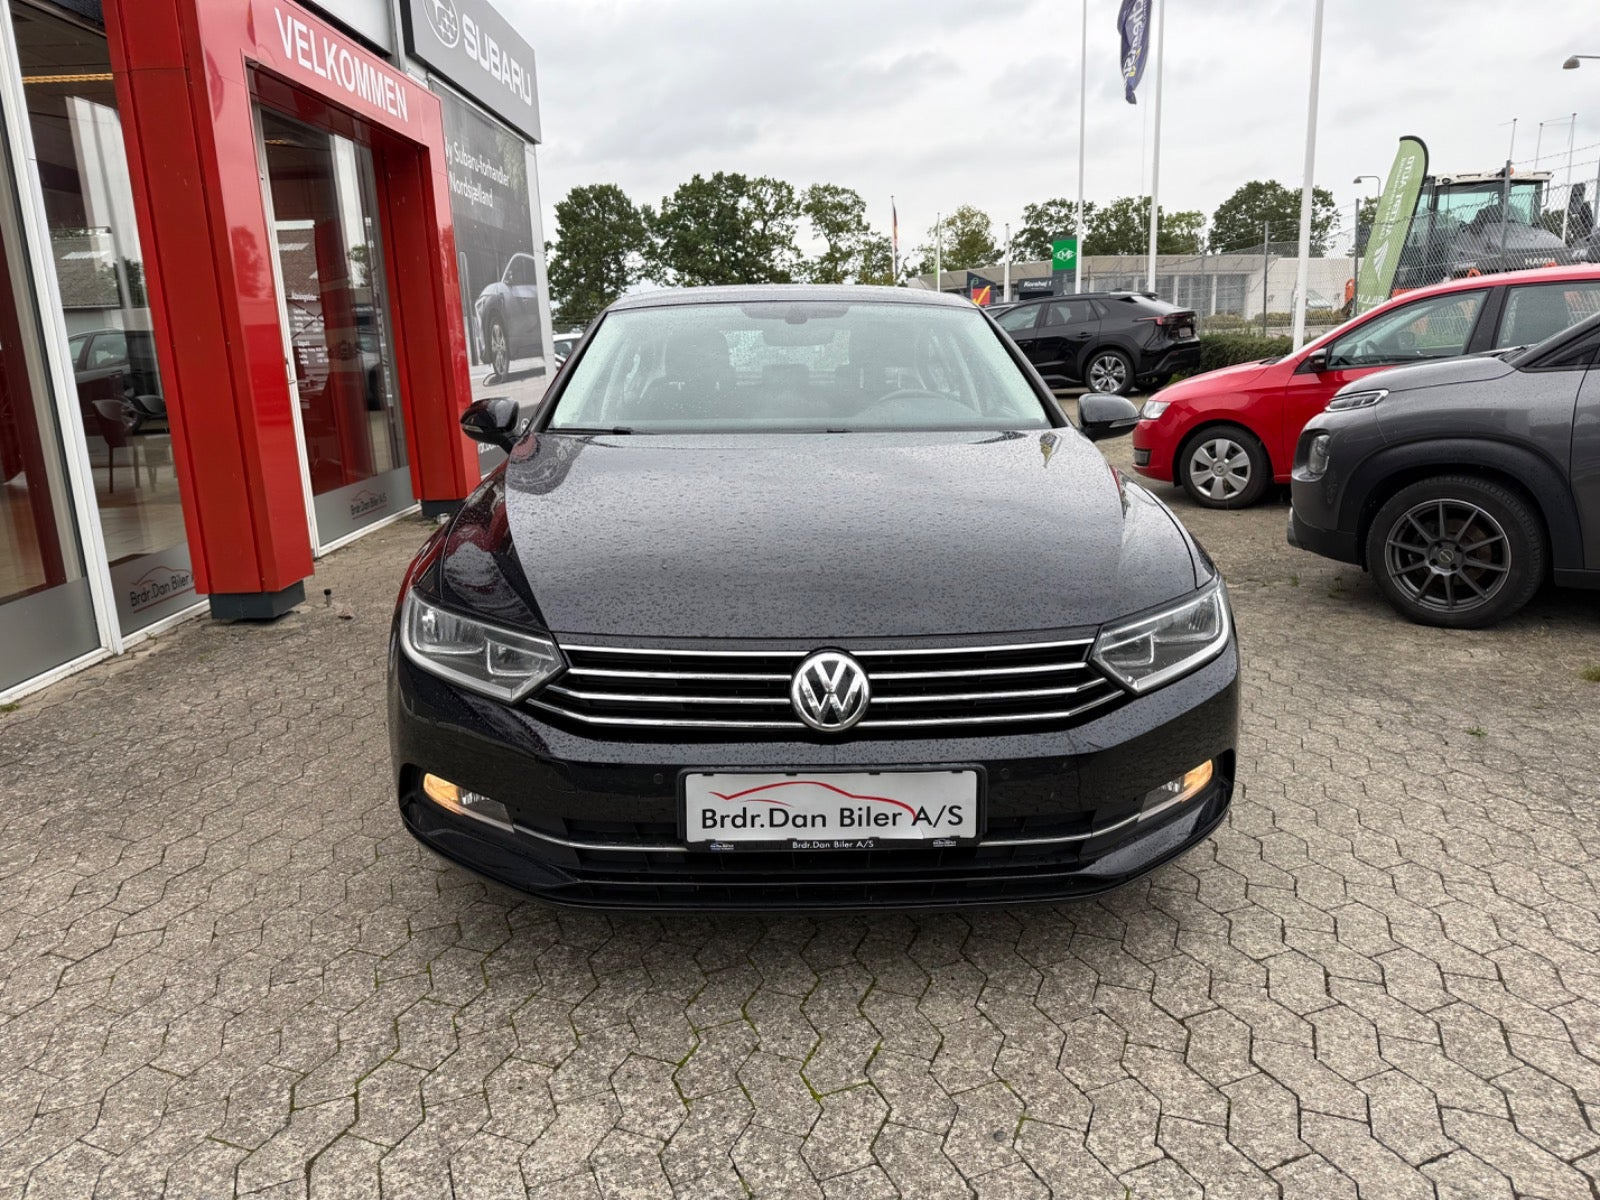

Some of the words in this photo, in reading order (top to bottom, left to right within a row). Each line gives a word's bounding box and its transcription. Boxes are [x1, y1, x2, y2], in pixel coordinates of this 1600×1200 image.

[274, 7, 409, 123] VELKOMMEN
[462, 14, 532, 106] SUBARU
[130, 582, 170, 607] Brdr.Dan
[171, 575, 189, 590] Biler
[702, 806, 827, 830] Brdr.Dan
[840, 805, 903, 828] Biler
[911, 805, 964, 828] A/S
[792, 840, 831, 849] Brdr.Dan
[834, 840, 853, 848] Biler
[856, 840, 874, 848] A/S
